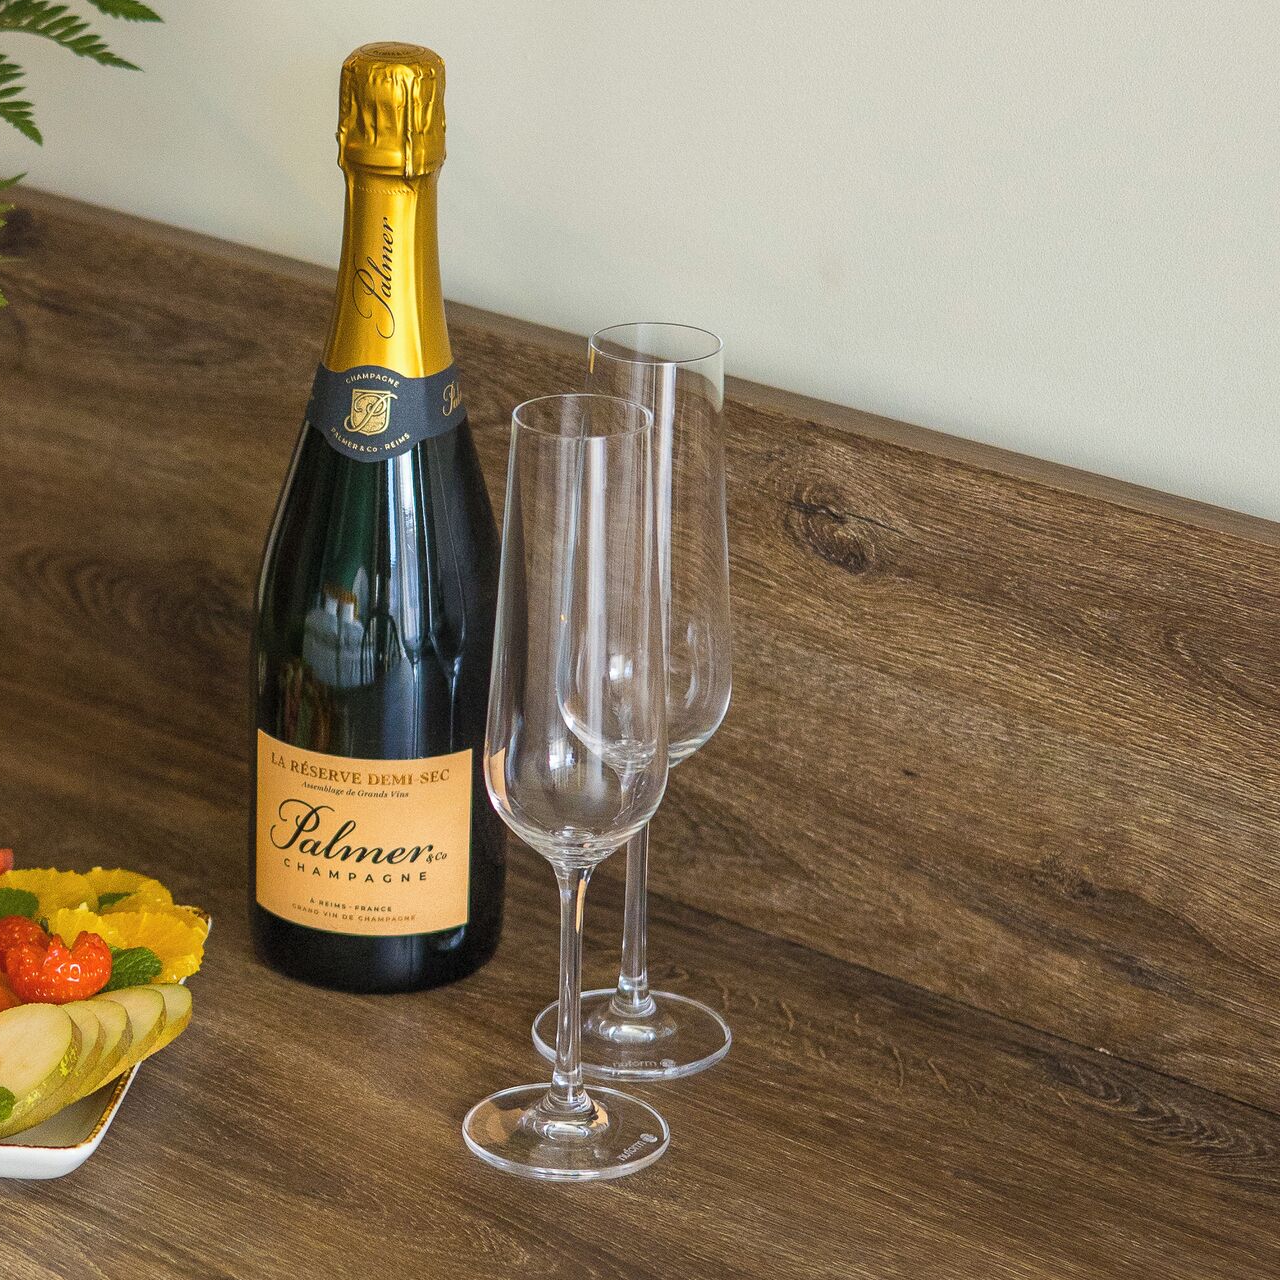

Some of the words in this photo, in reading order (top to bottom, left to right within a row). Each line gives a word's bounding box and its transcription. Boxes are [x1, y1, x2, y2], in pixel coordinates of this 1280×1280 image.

[352, 216, 395, 339] Palmer
[345, 373, 400, 388] CHAMPAGNE
[330, 427, 358, 450] PALMER
[384, 432, 410, 451] REIMS
[271, 752, 286, 769] LA
[290, 759, 362, 785] RÉSERVE
[301, 781, 344, 796] Assemblage
[357, 790, 388, 798] Grands
[270, 798, 433, 865] Palmer
[283, 858, 427, 883] CHAMPAGNE
[292, 903, 319, 915] GRAND
[324, 911, 338, 919] VIN
[358, 914, 417, 922] CHAMPAGNE
[319, 899, 346, 909] REIMS
